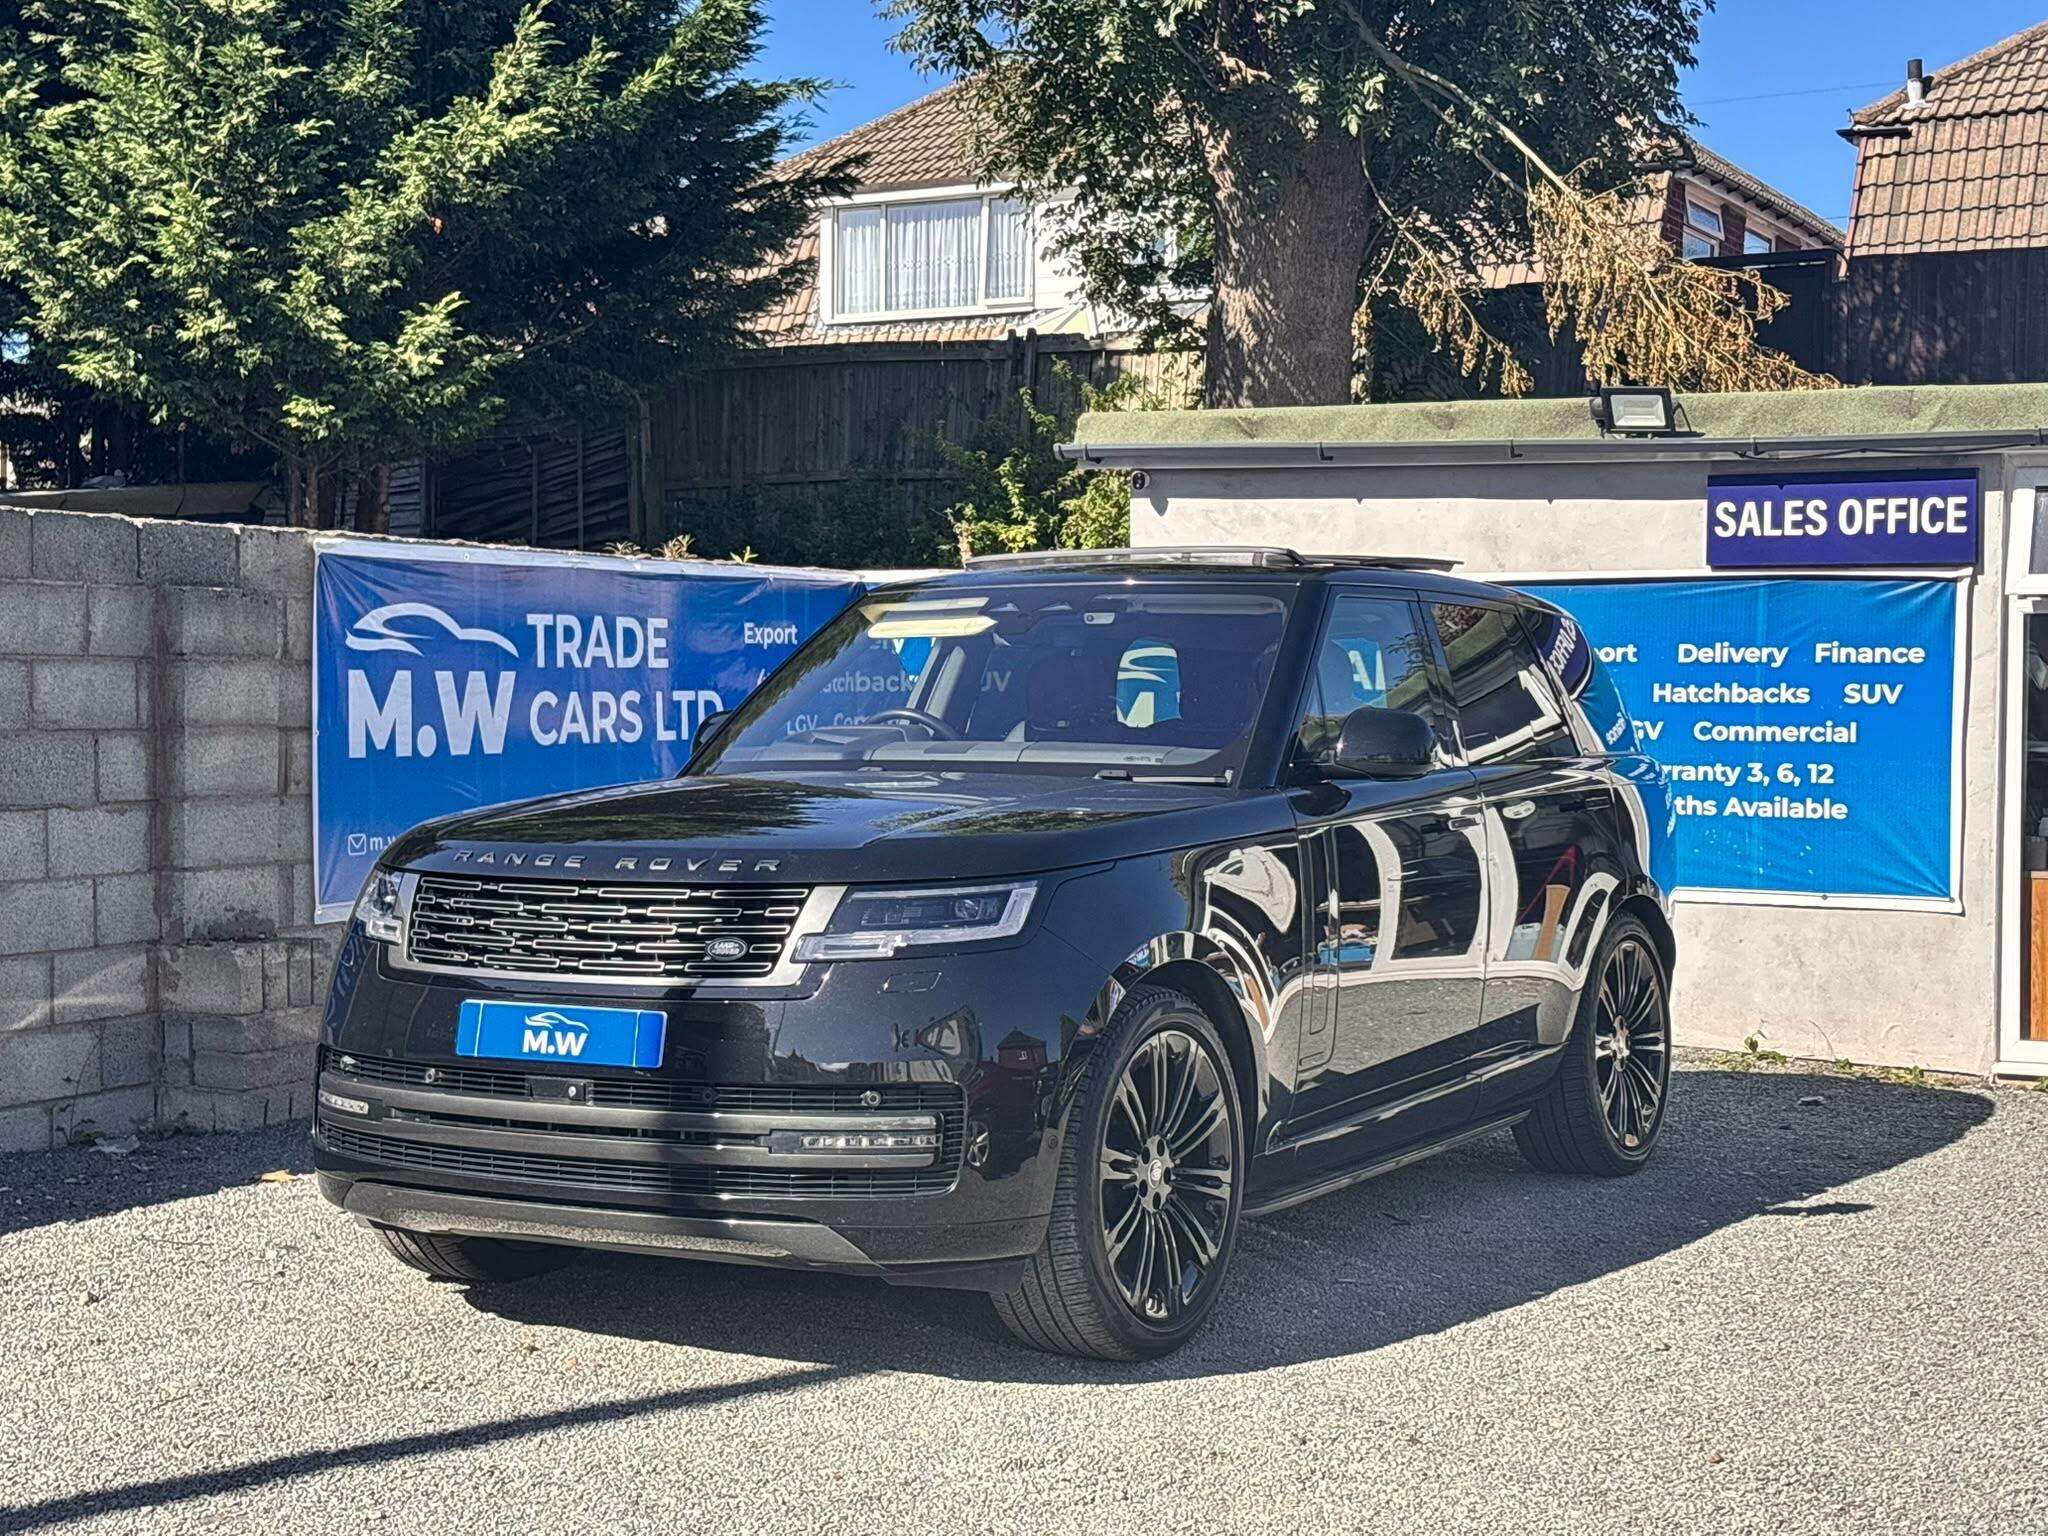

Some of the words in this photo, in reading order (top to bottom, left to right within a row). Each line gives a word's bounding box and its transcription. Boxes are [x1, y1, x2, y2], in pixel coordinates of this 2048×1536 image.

[1714, 499, 1828, 538] SALES
[1838, 496, 1968, 536] OFFICE
[526, 613, 670, 669] TRADE
[743, 622, 798, 649] Export
[1678, 641, 1789, 668] Delivery
[1815, 641, 1926, 664] Finance
[1653, 682, 1811, 704] Hatchbacks
[1843, 683, 1903, 705] SUV
[348, 669, 517, 759] M.W
[529, 690, 643, 746] CARS
[1693, 720, 1857, 743] Commercial
[1747, 762, 1770, 786] 3,
[1776, 763, 1801, 787] 6,
[1807, 763, 1834, 784] 12
[1722, 796, 1848, 820] Available
[453, 849, 587, 869] RANGE
[614, 856, 782, 872] ROVER
[522, 1029, 588, 1057] M.W
